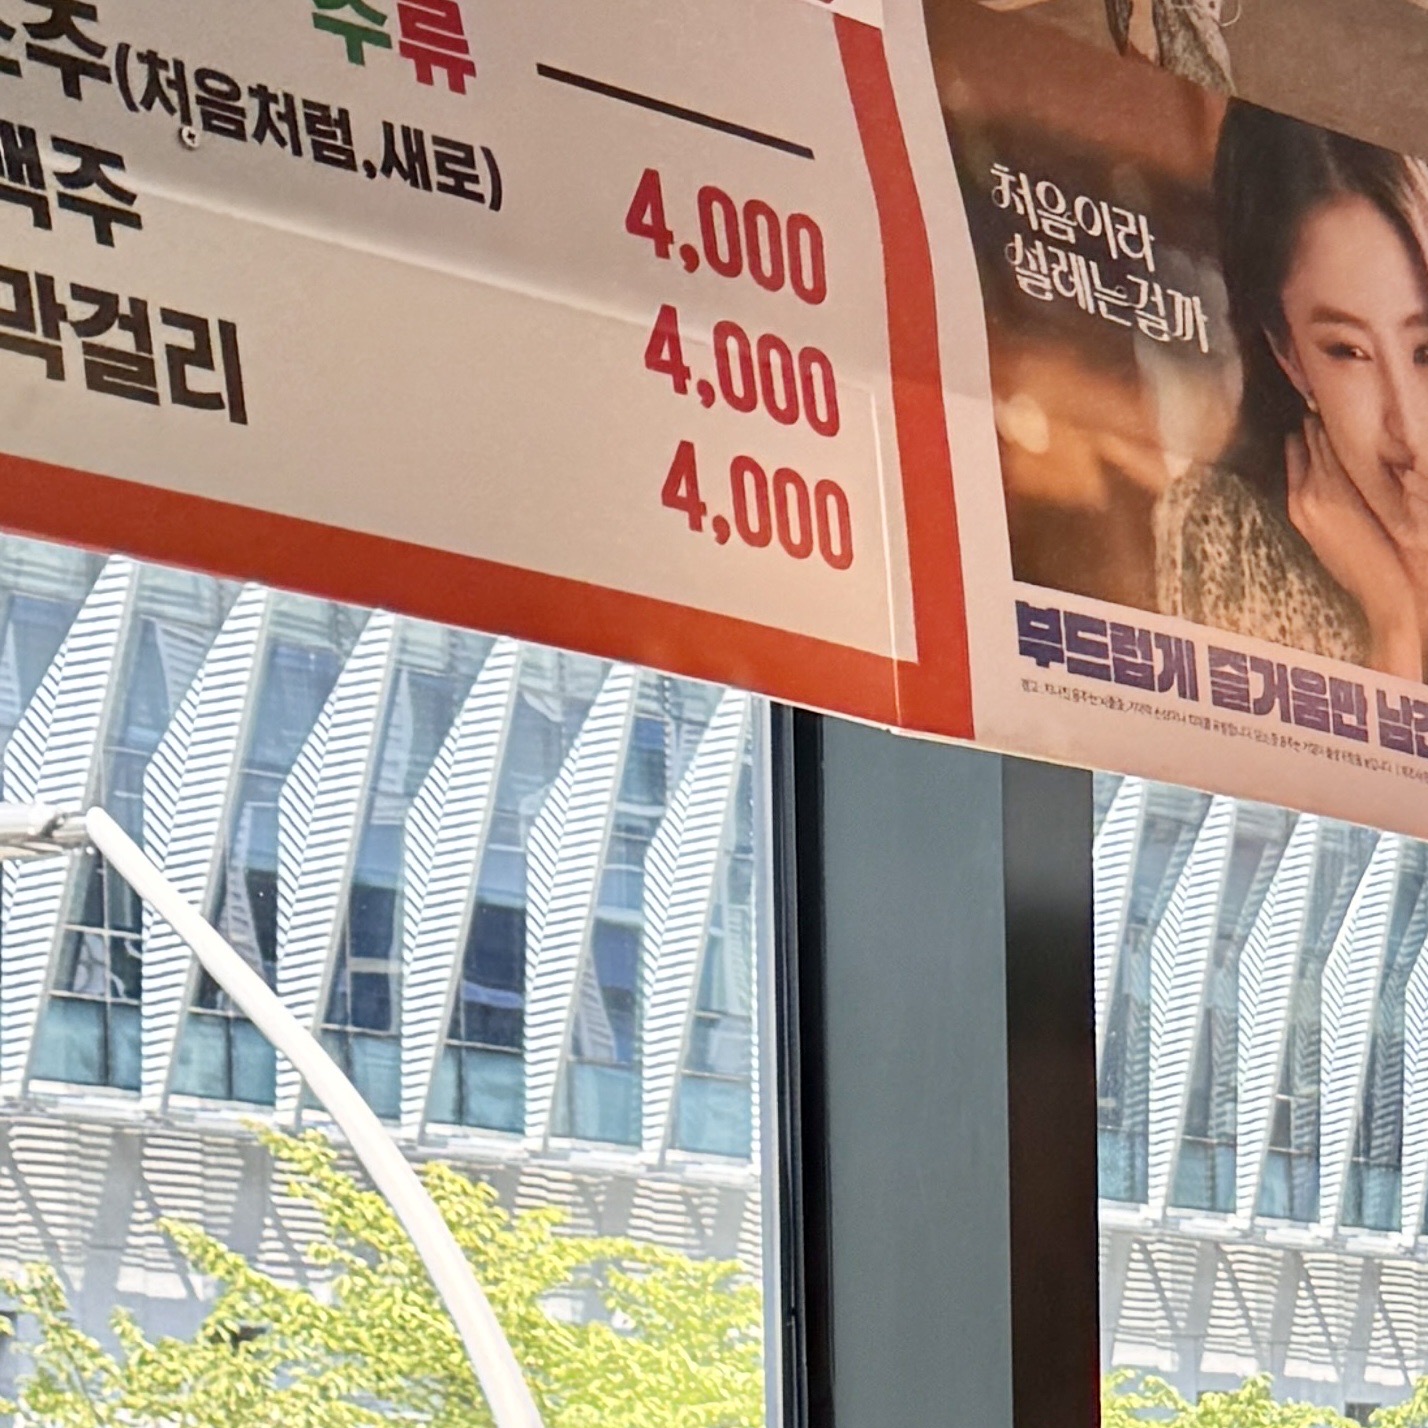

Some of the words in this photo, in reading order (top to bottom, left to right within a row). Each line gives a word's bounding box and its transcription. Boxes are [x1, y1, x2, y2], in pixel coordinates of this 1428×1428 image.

[0, 0, 503, 212] 주(처음처럼,새로)
[625, 167, 827, 305] 4,000
[990, 162, 1156, 273] 처음이라
[0, 264, 248, 426] 막걸리
[644, 303, 840, 438] 4,000
[661, 439, 854, 571] 4,000
[1014, 599, 1200, 702] 부드럽게
[1208, 644, 1370, 744] 즐거움만
